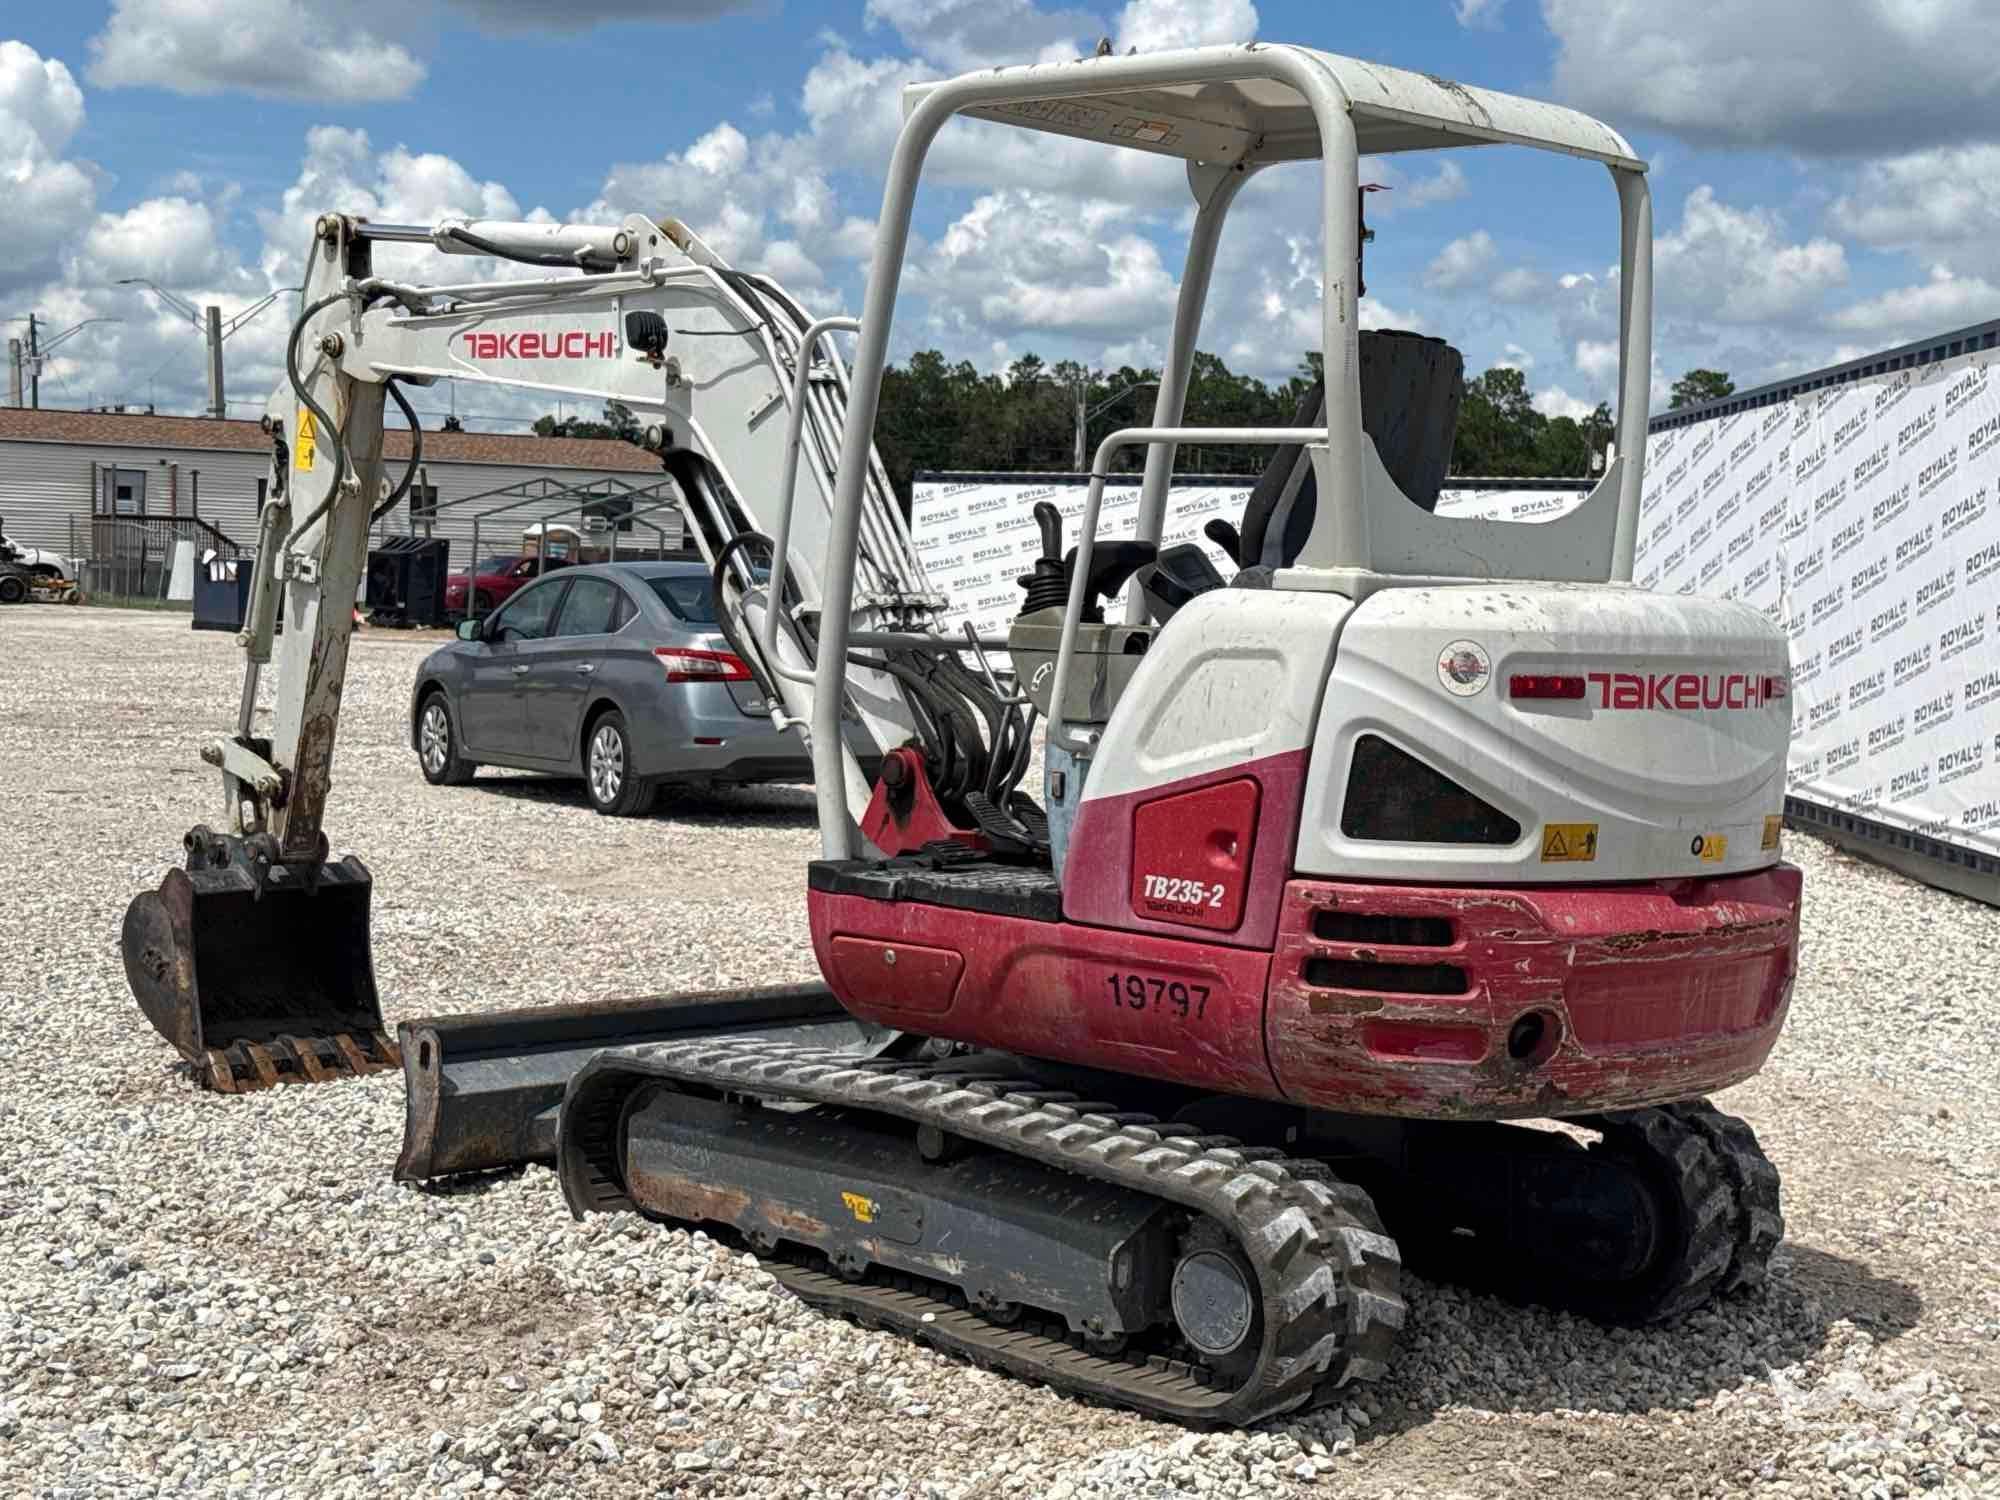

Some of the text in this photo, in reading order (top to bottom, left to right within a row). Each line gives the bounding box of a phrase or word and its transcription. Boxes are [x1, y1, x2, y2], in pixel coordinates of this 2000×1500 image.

[1875, 376, 1903, 408] ROYAL
[1945, 371, 1978, 408] ROYAL
[1834, 415, 1859, 445] ROYAL
[1898, 412, 1928, 446] ROYAL
[1854, 449, 1881, 480] ROYAL
[1919, 454, 1948, 487] ROYAL
[968, 499, 998, 511] ROYAL
[1017, 488, 1047, 499] ROYAL
[1511, 499, 1552, 513] ROYAL
[1815, 484, 1840, 511] ROYAL
[1873, 490, 1901, 520] ROYAL
[921, 510, 950, 521] ROYAL
[1176, 502, 1209, 513] ROYAL
[1942, 495, 1976, 528] ROYAL
[948, 527, 977, 540] ROYAL
[996, 517, 1027, 529] ROYAL
[1832, 523, 1857, 549] ROYAL
[973, 547, 1002, 558] ROYAL
[1896, 529, 1924, 560] ROYAL
[926, 557, 956, 568] ROYAL
[1852, 562, 1879, 589] ROYAL
[953, 575, 982, 586] ROYAL
[1916, 575, 1945, 604] ROYAL
[1812, 590, 1836, 615] ROYAL
[1871, 606, 1899, 632] ROYAL
[1829, 632, 1854, 658] ROYAL
[1940, 620, 1974, 649] ROYAL
[1894, 649, 1922, 676] ROYAL
[1849, 674, 1877, 699] ROYAL
[1810, 700, 1834, 720] ROYAL
[1914, 697, 1944, 722] ROYAL
[1868, 719, 1897, 745] ROYAL
[1826, 742, 1852, 764] ROYAL
[1938, 746, 1973, 772] ROYAL
[1890, 767, 1921, 792] ROYAL
[1144, 875, 1225, 908] TB235-2
[1108, 972, 1210, 1018] 19797
